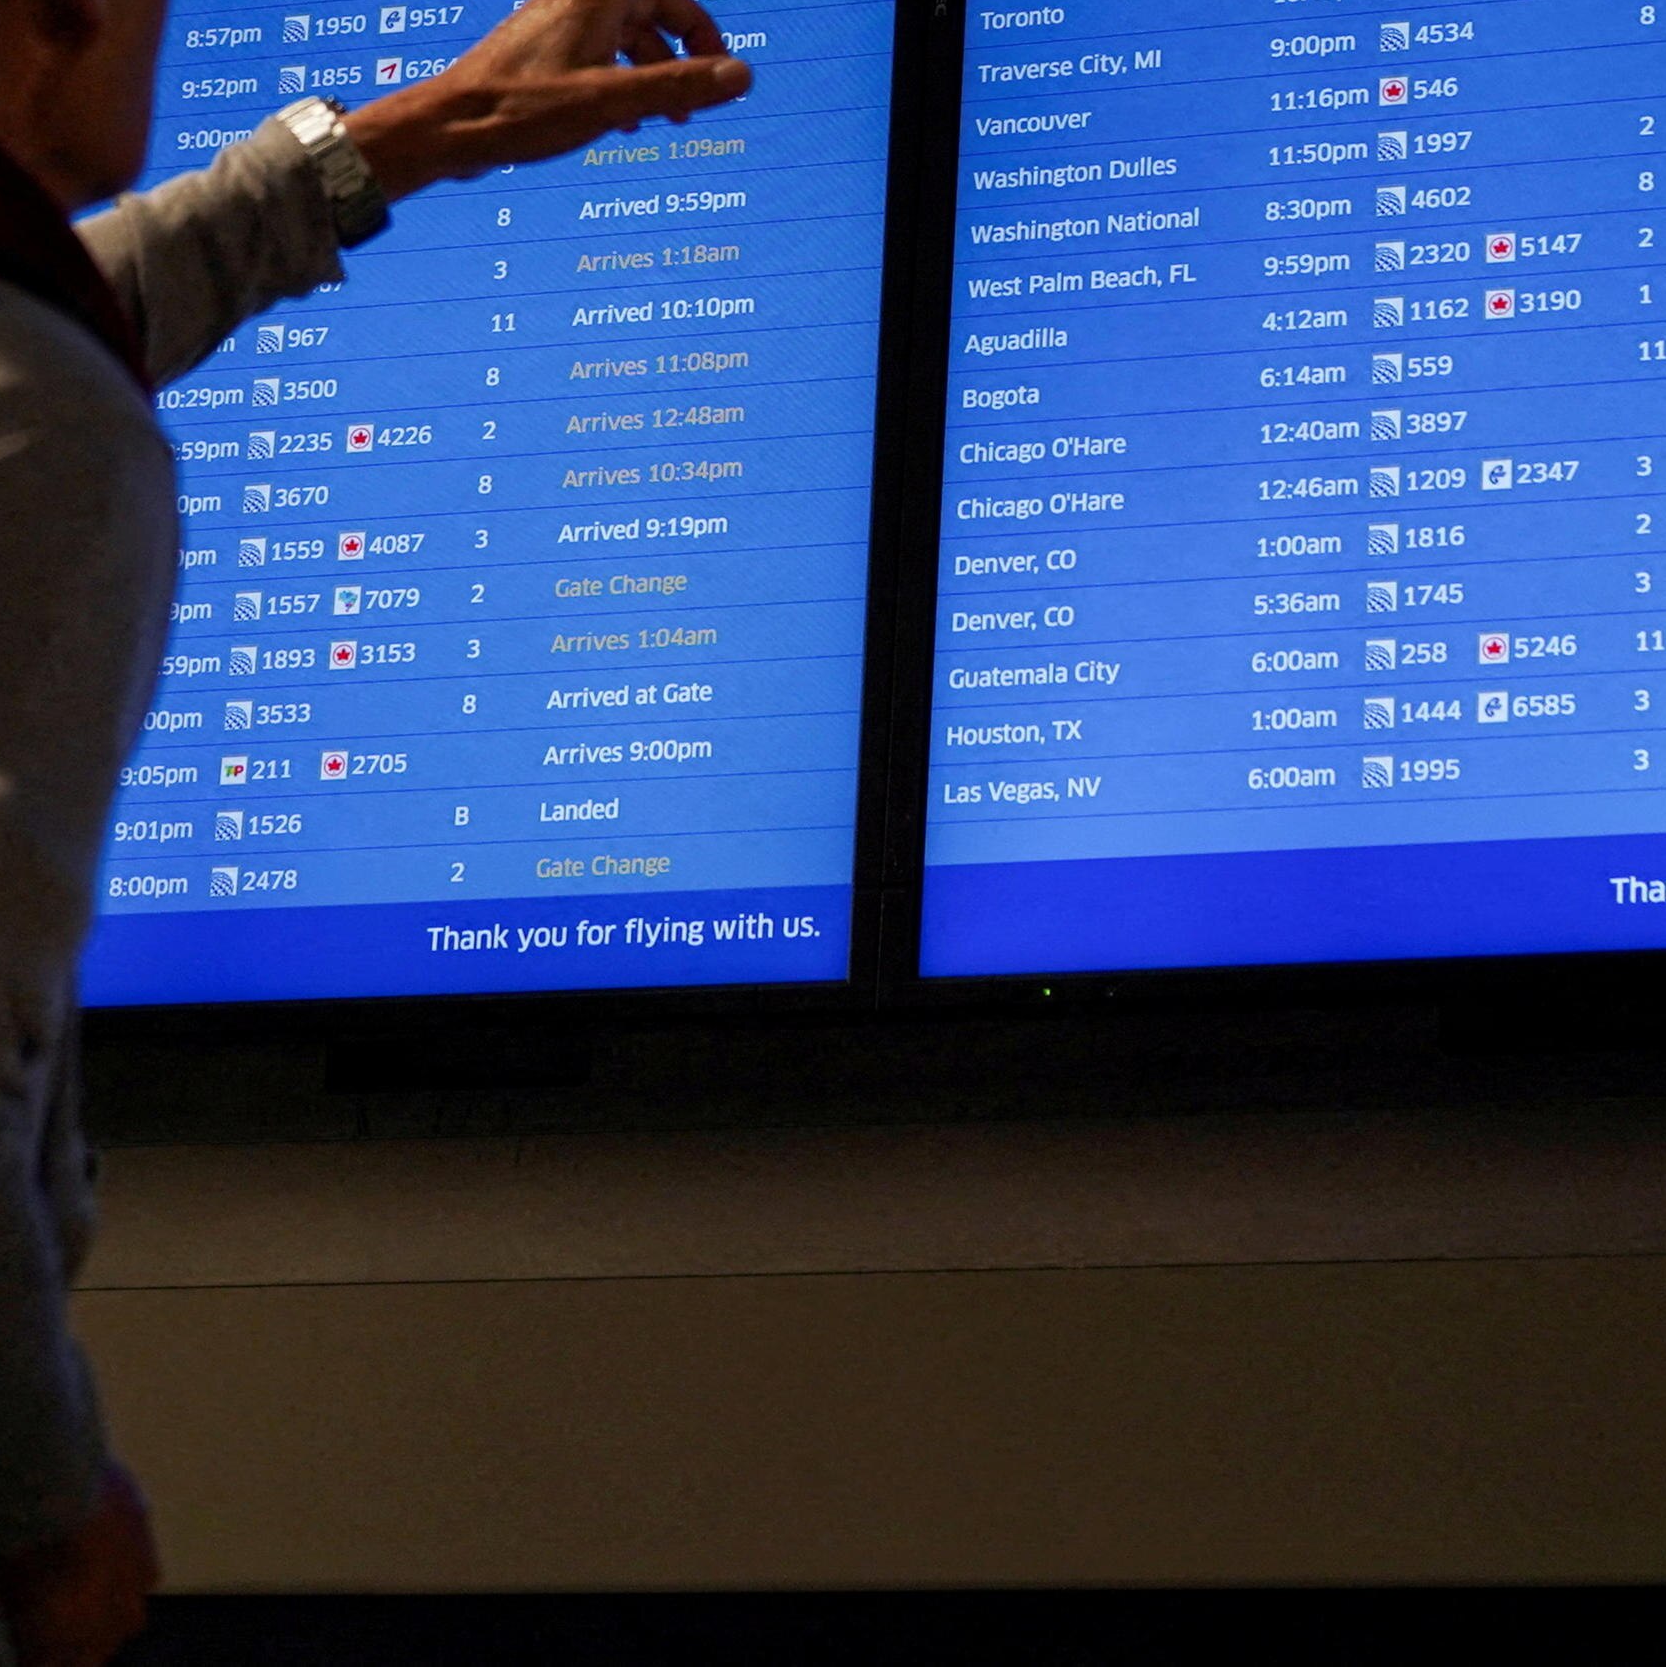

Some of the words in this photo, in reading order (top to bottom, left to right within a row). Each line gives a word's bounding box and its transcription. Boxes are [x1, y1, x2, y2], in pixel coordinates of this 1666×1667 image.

[1270, 87, 1370, 112] 11:16pm
[1413, 76, 1459, 100] 546
[975, 111, 1092, 137] Vancouver
[1400, 758, 1461, 783] 1995
[1633, 748, 1650, 771] 3
[1247, 765, 1336, 790] 6:00am
[943, 783, 983, 804] Las
[987, 780, 1061, 805] Vegas,
[1067, 776, 1102, 798] NV
[450, 861, 465, 883] 2
[535, 857, 585, 879] Gate
[590, 853, 671, 878] Change
[108, 875, 189, 899] 8:00pm
[241, 869, 298, 892] 2478
[426, 923, 510, 952] Thank
[516, 926, 568, 953] you
[575, 919, 617, 946] for
[624, 916, 705, 949] flying
[712, 912, 774, 941] with
[782, 915, 821, 939] us.
